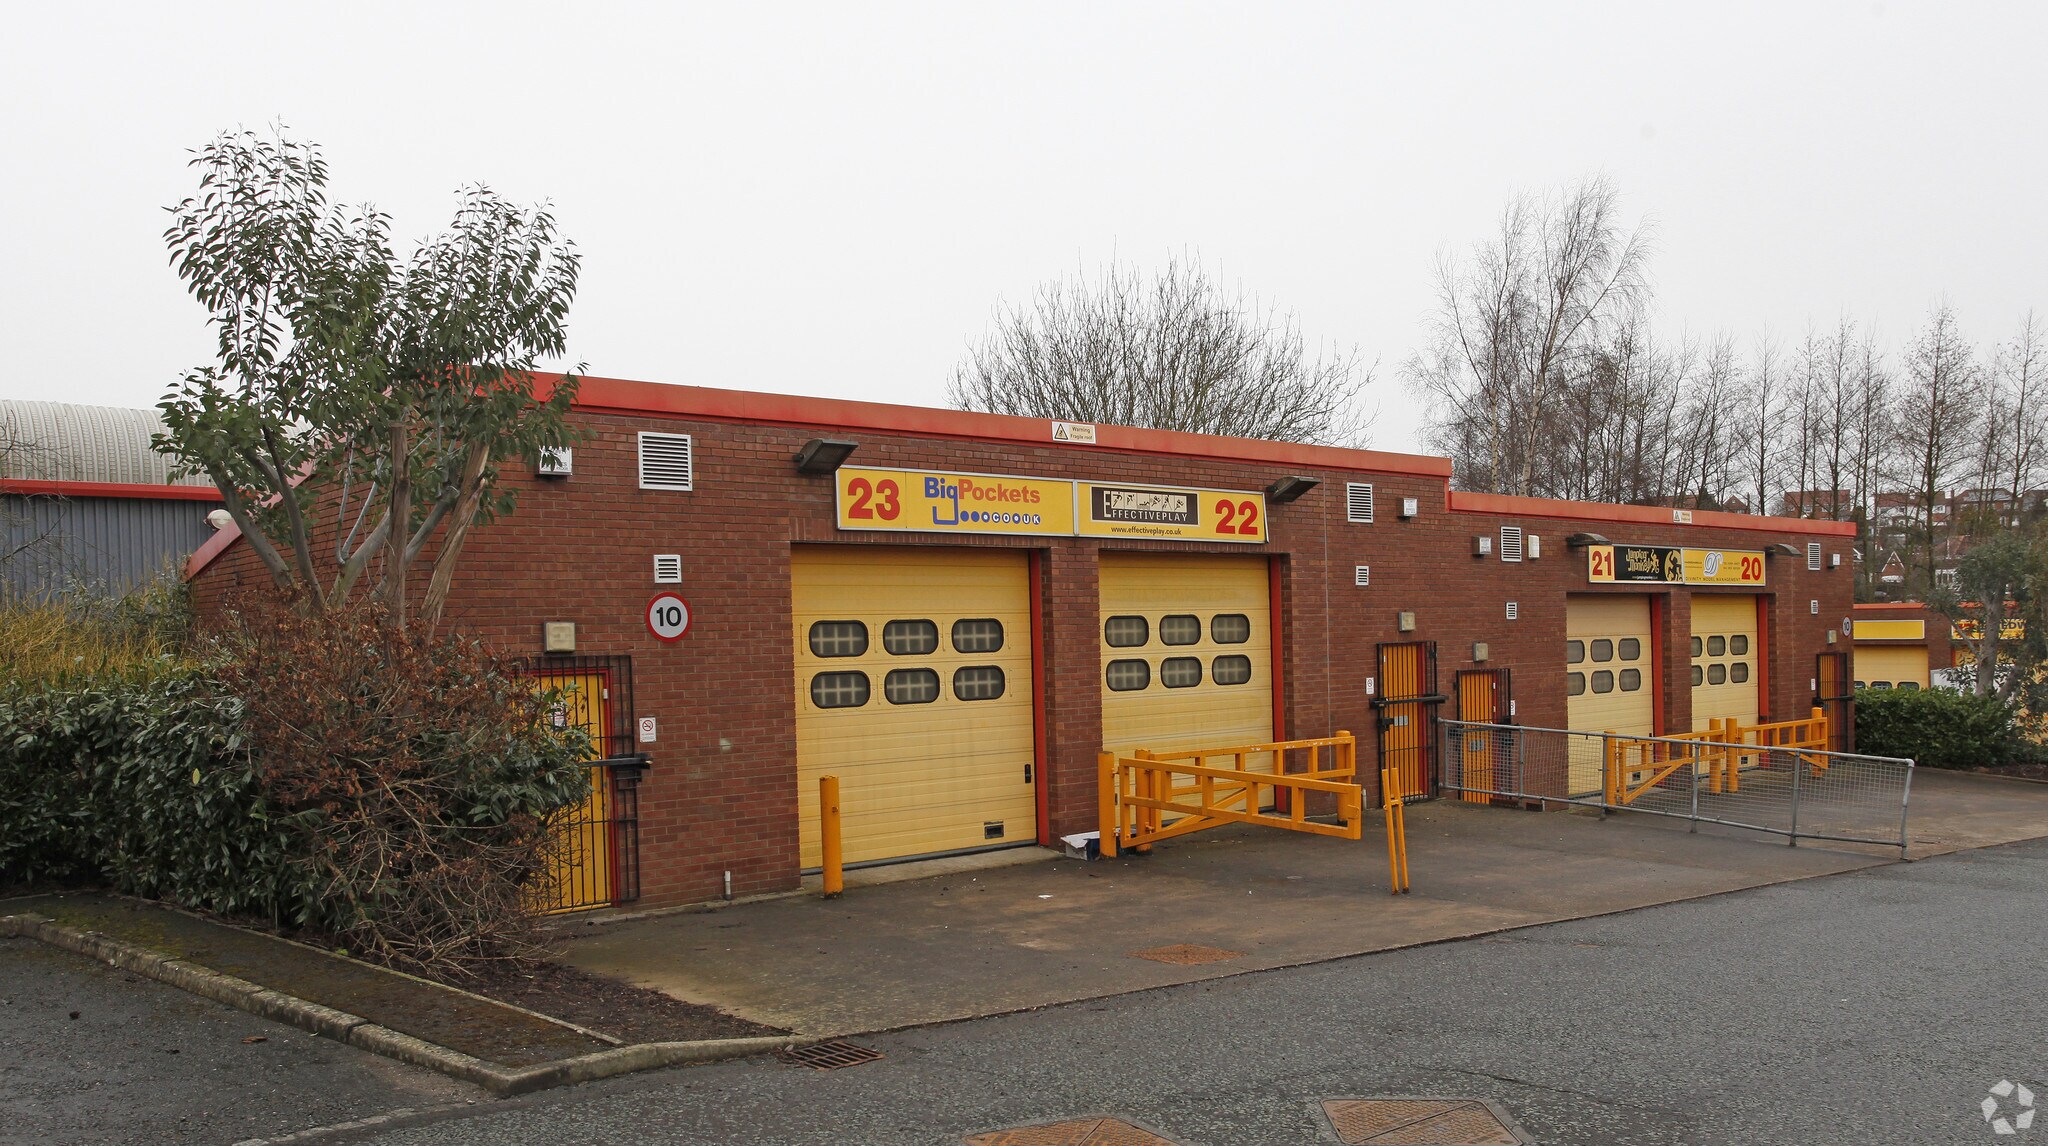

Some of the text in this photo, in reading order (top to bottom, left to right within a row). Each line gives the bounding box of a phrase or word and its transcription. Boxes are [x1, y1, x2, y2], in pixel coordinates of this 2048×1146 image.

[1072, 426, 1091, 434] Warning
[847, 477, 901, 521] 23
[1103, 490, 1188, 522] EFFECTIVEPLAY
[1215, 499, 1259, 536] 22
[1110, 524, 1183, 537] www.effectiveplay.co.uk
[1592, 550, 1612, 576] 21
[1741, 556, 1762, 581] 20
[656, 606, 682, 627] 10
